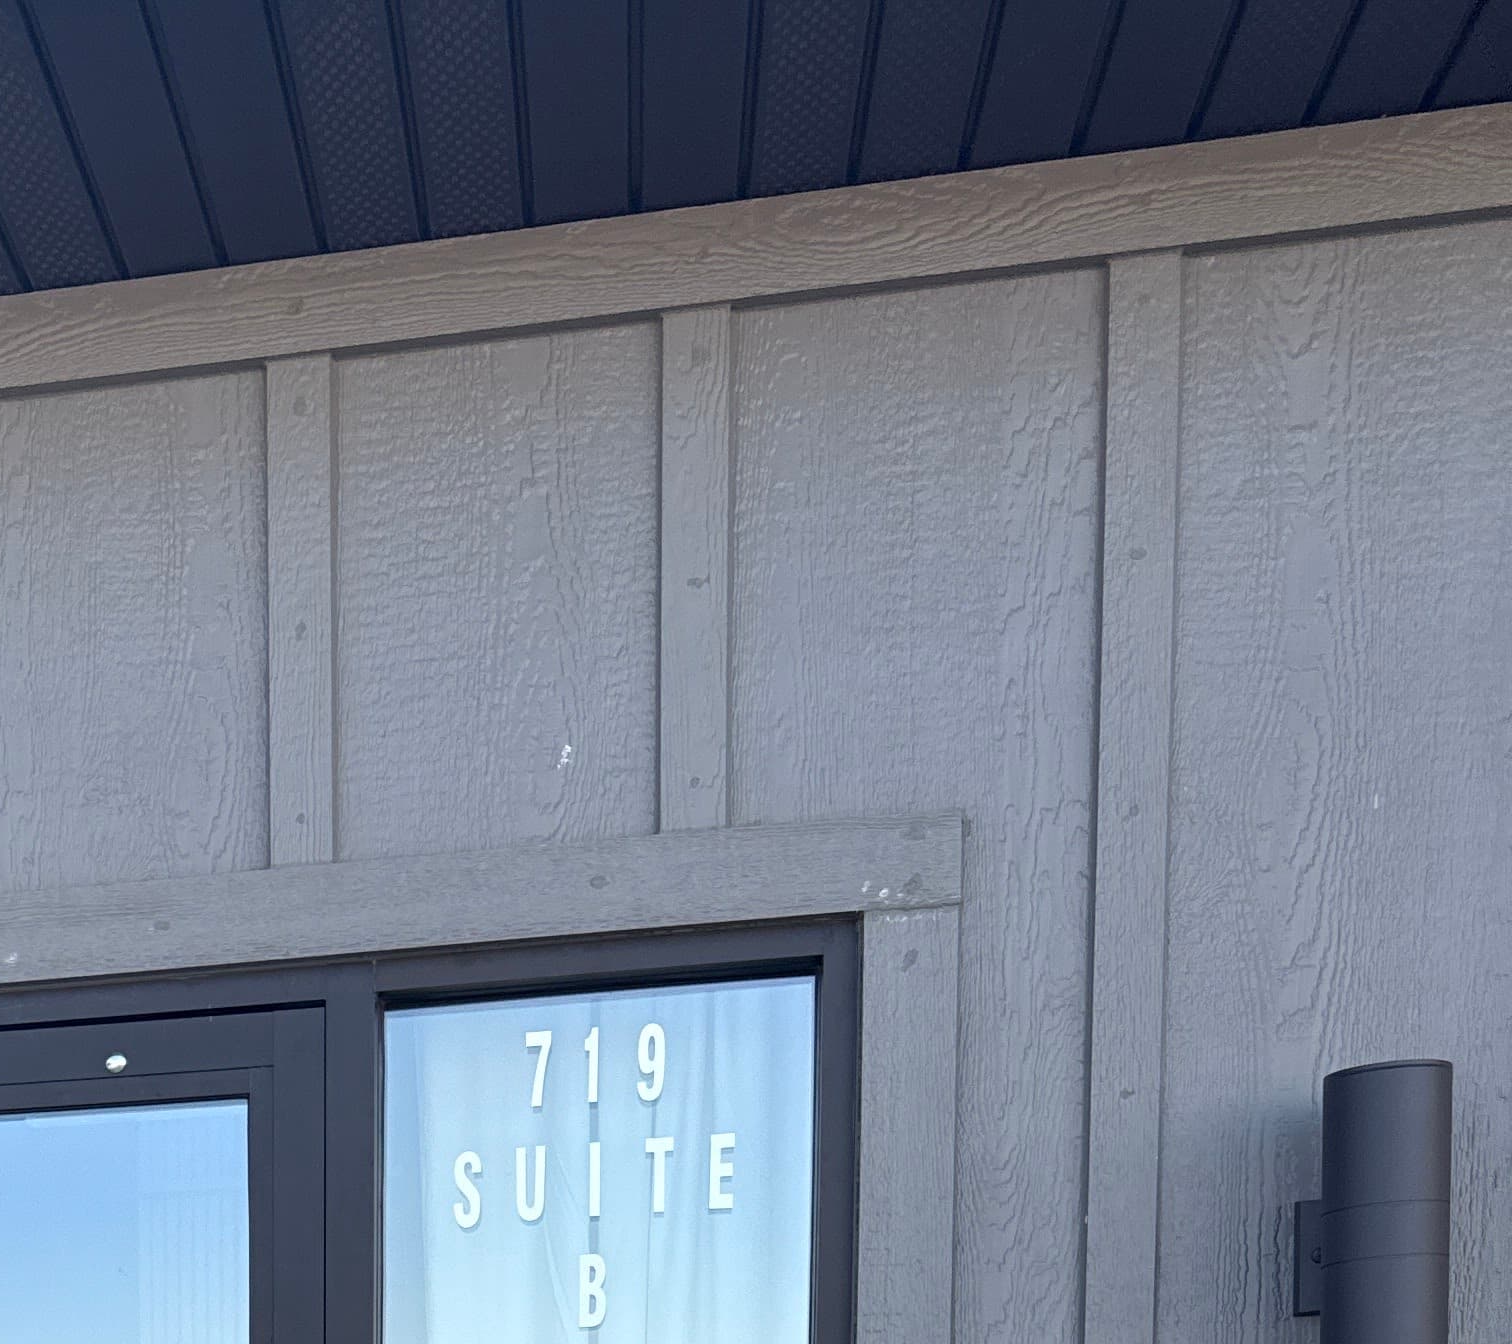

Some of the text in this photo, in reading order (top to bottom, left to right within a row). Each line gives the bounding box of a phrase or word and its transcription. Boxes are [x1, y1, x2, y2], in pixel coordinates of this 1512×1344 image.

[524, 1022, 666, 1108] 719
[452, 1132, 736, 1229] SUITE
[578, 1253, 607, 1329] B
